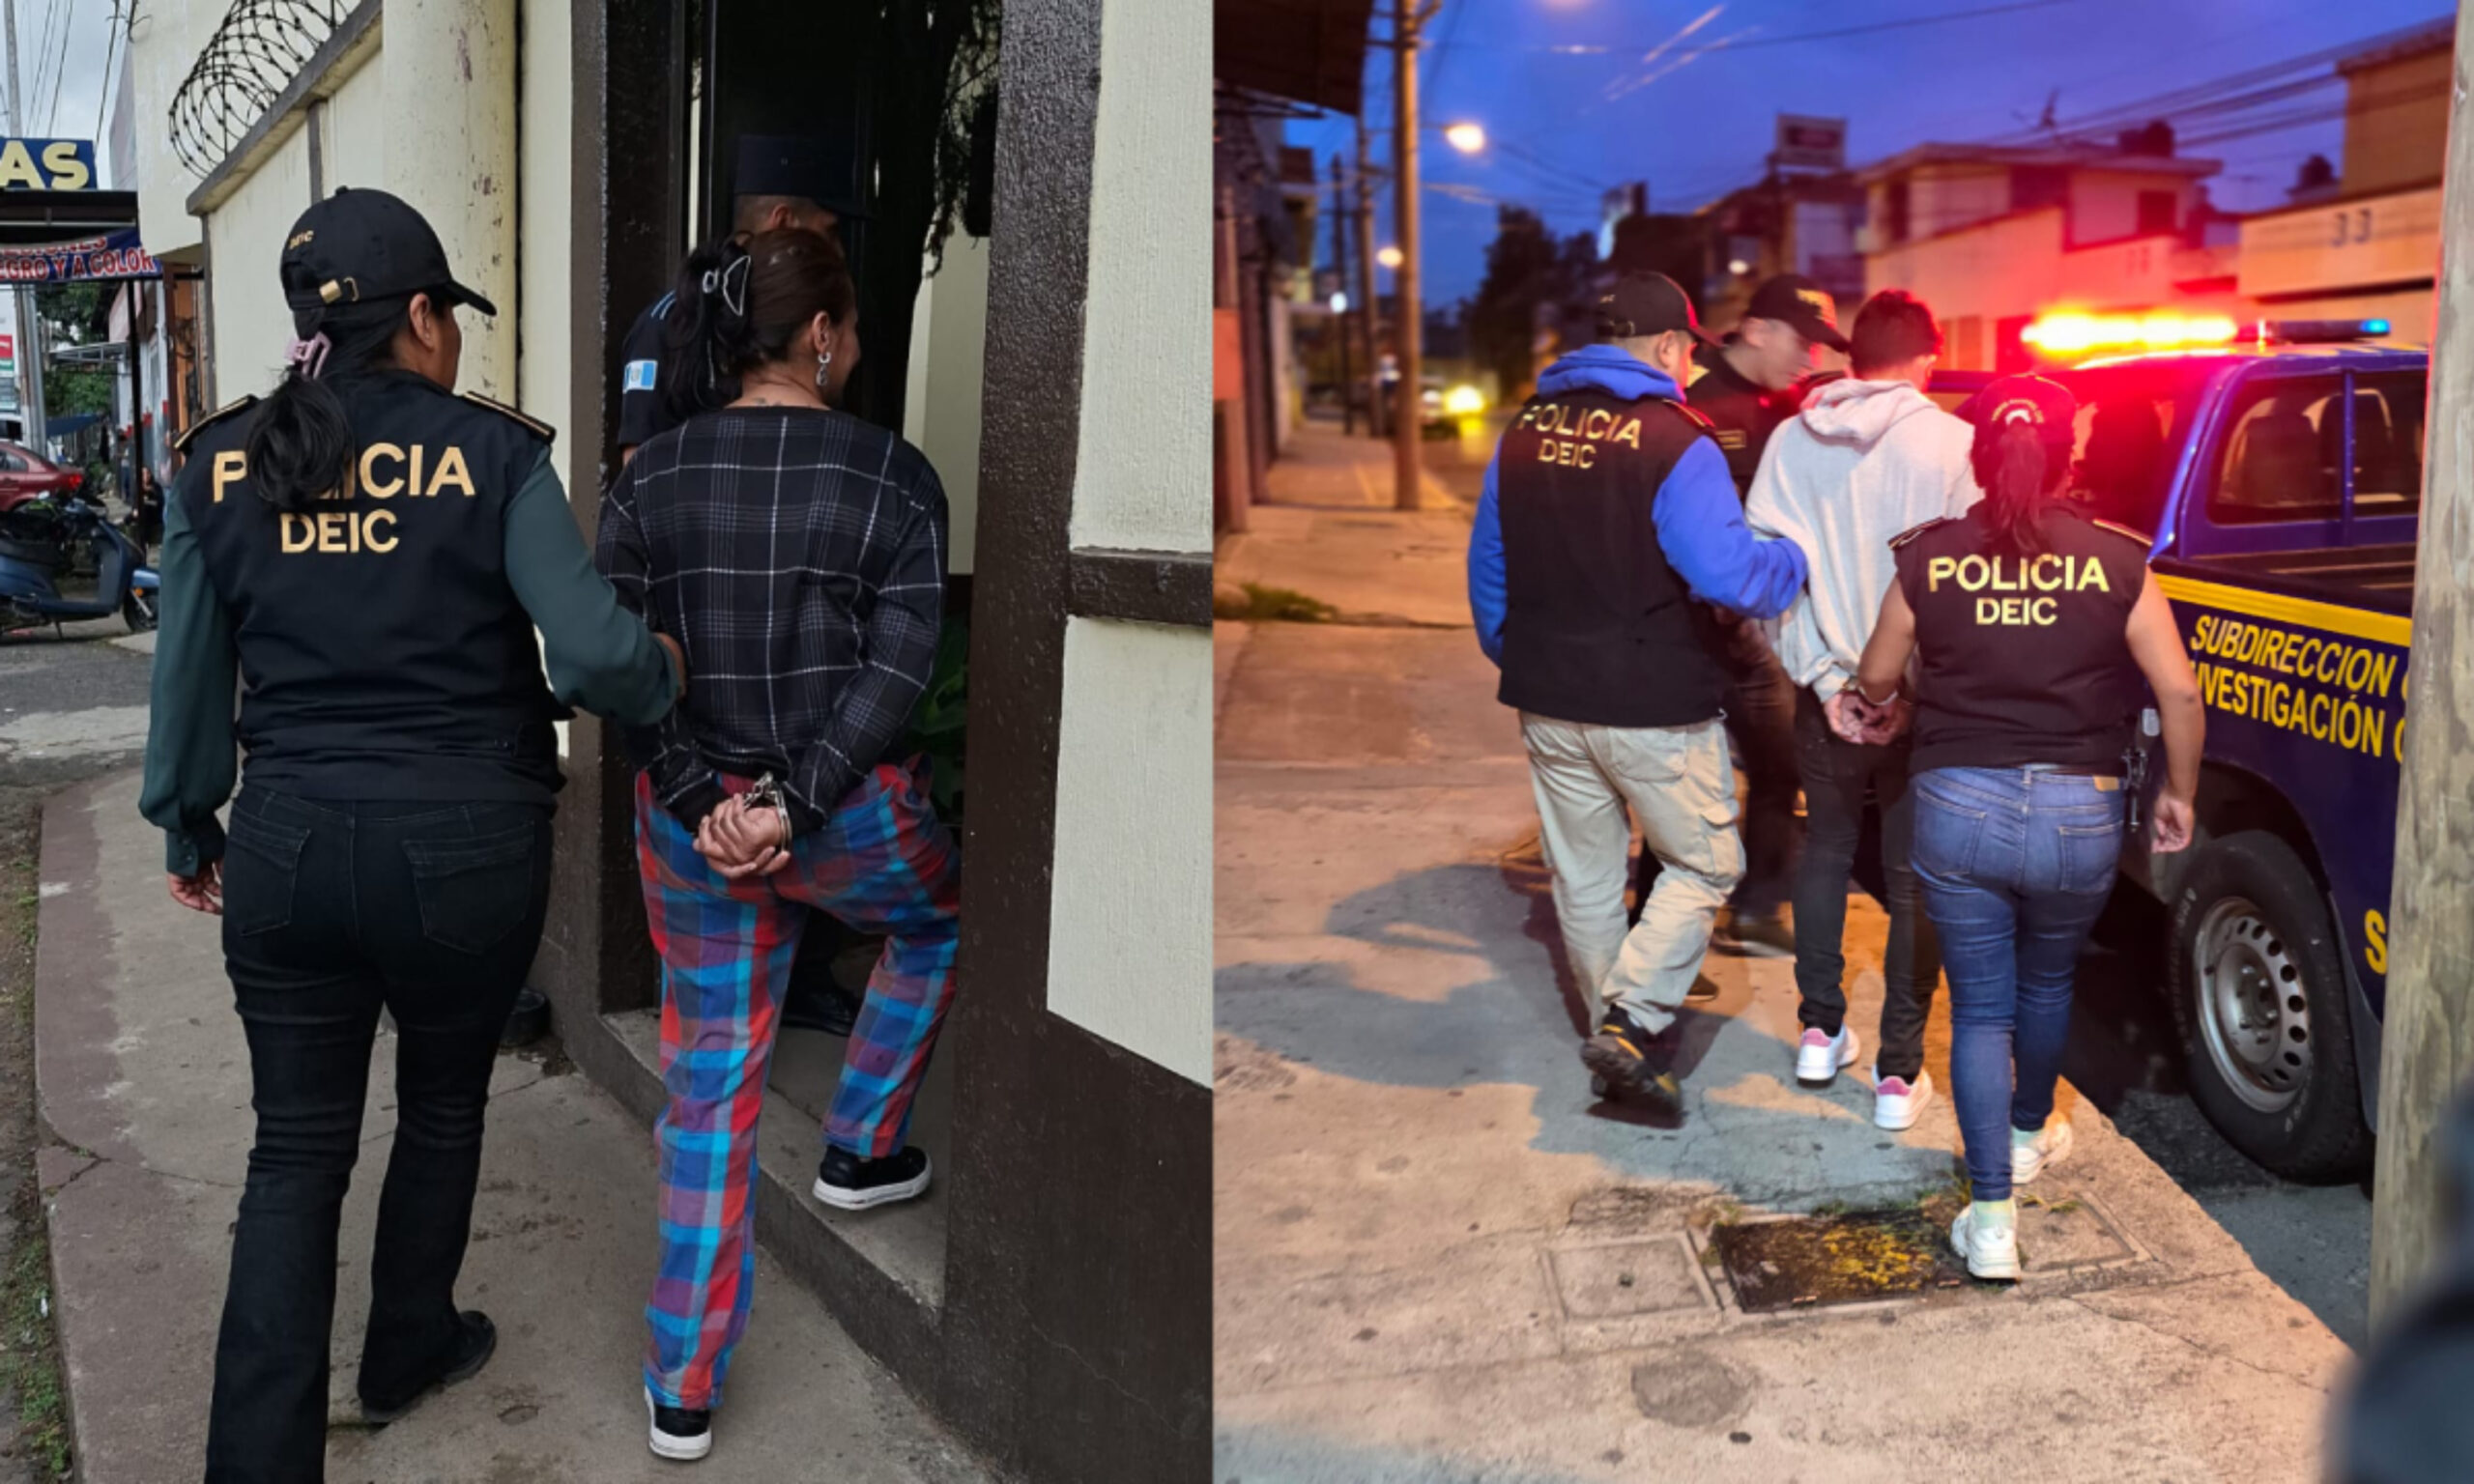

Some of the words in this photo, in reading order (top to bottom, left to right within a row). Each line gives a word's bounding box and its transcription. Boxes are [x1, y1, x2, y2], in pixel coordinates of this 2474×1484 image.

[1516, 403, 1642, 450] POLICIA
[213, 442, 476, 503] PICIA
[1538, 438, 1597, 469] DEIC
[279, 508, 400, 554] DEIC
[1928, 554, 2111, 592] POLICIA
[1976, 597, 2058, 626] DEIC
[2189, 614, 2398, 699] SUBDIRECCION
